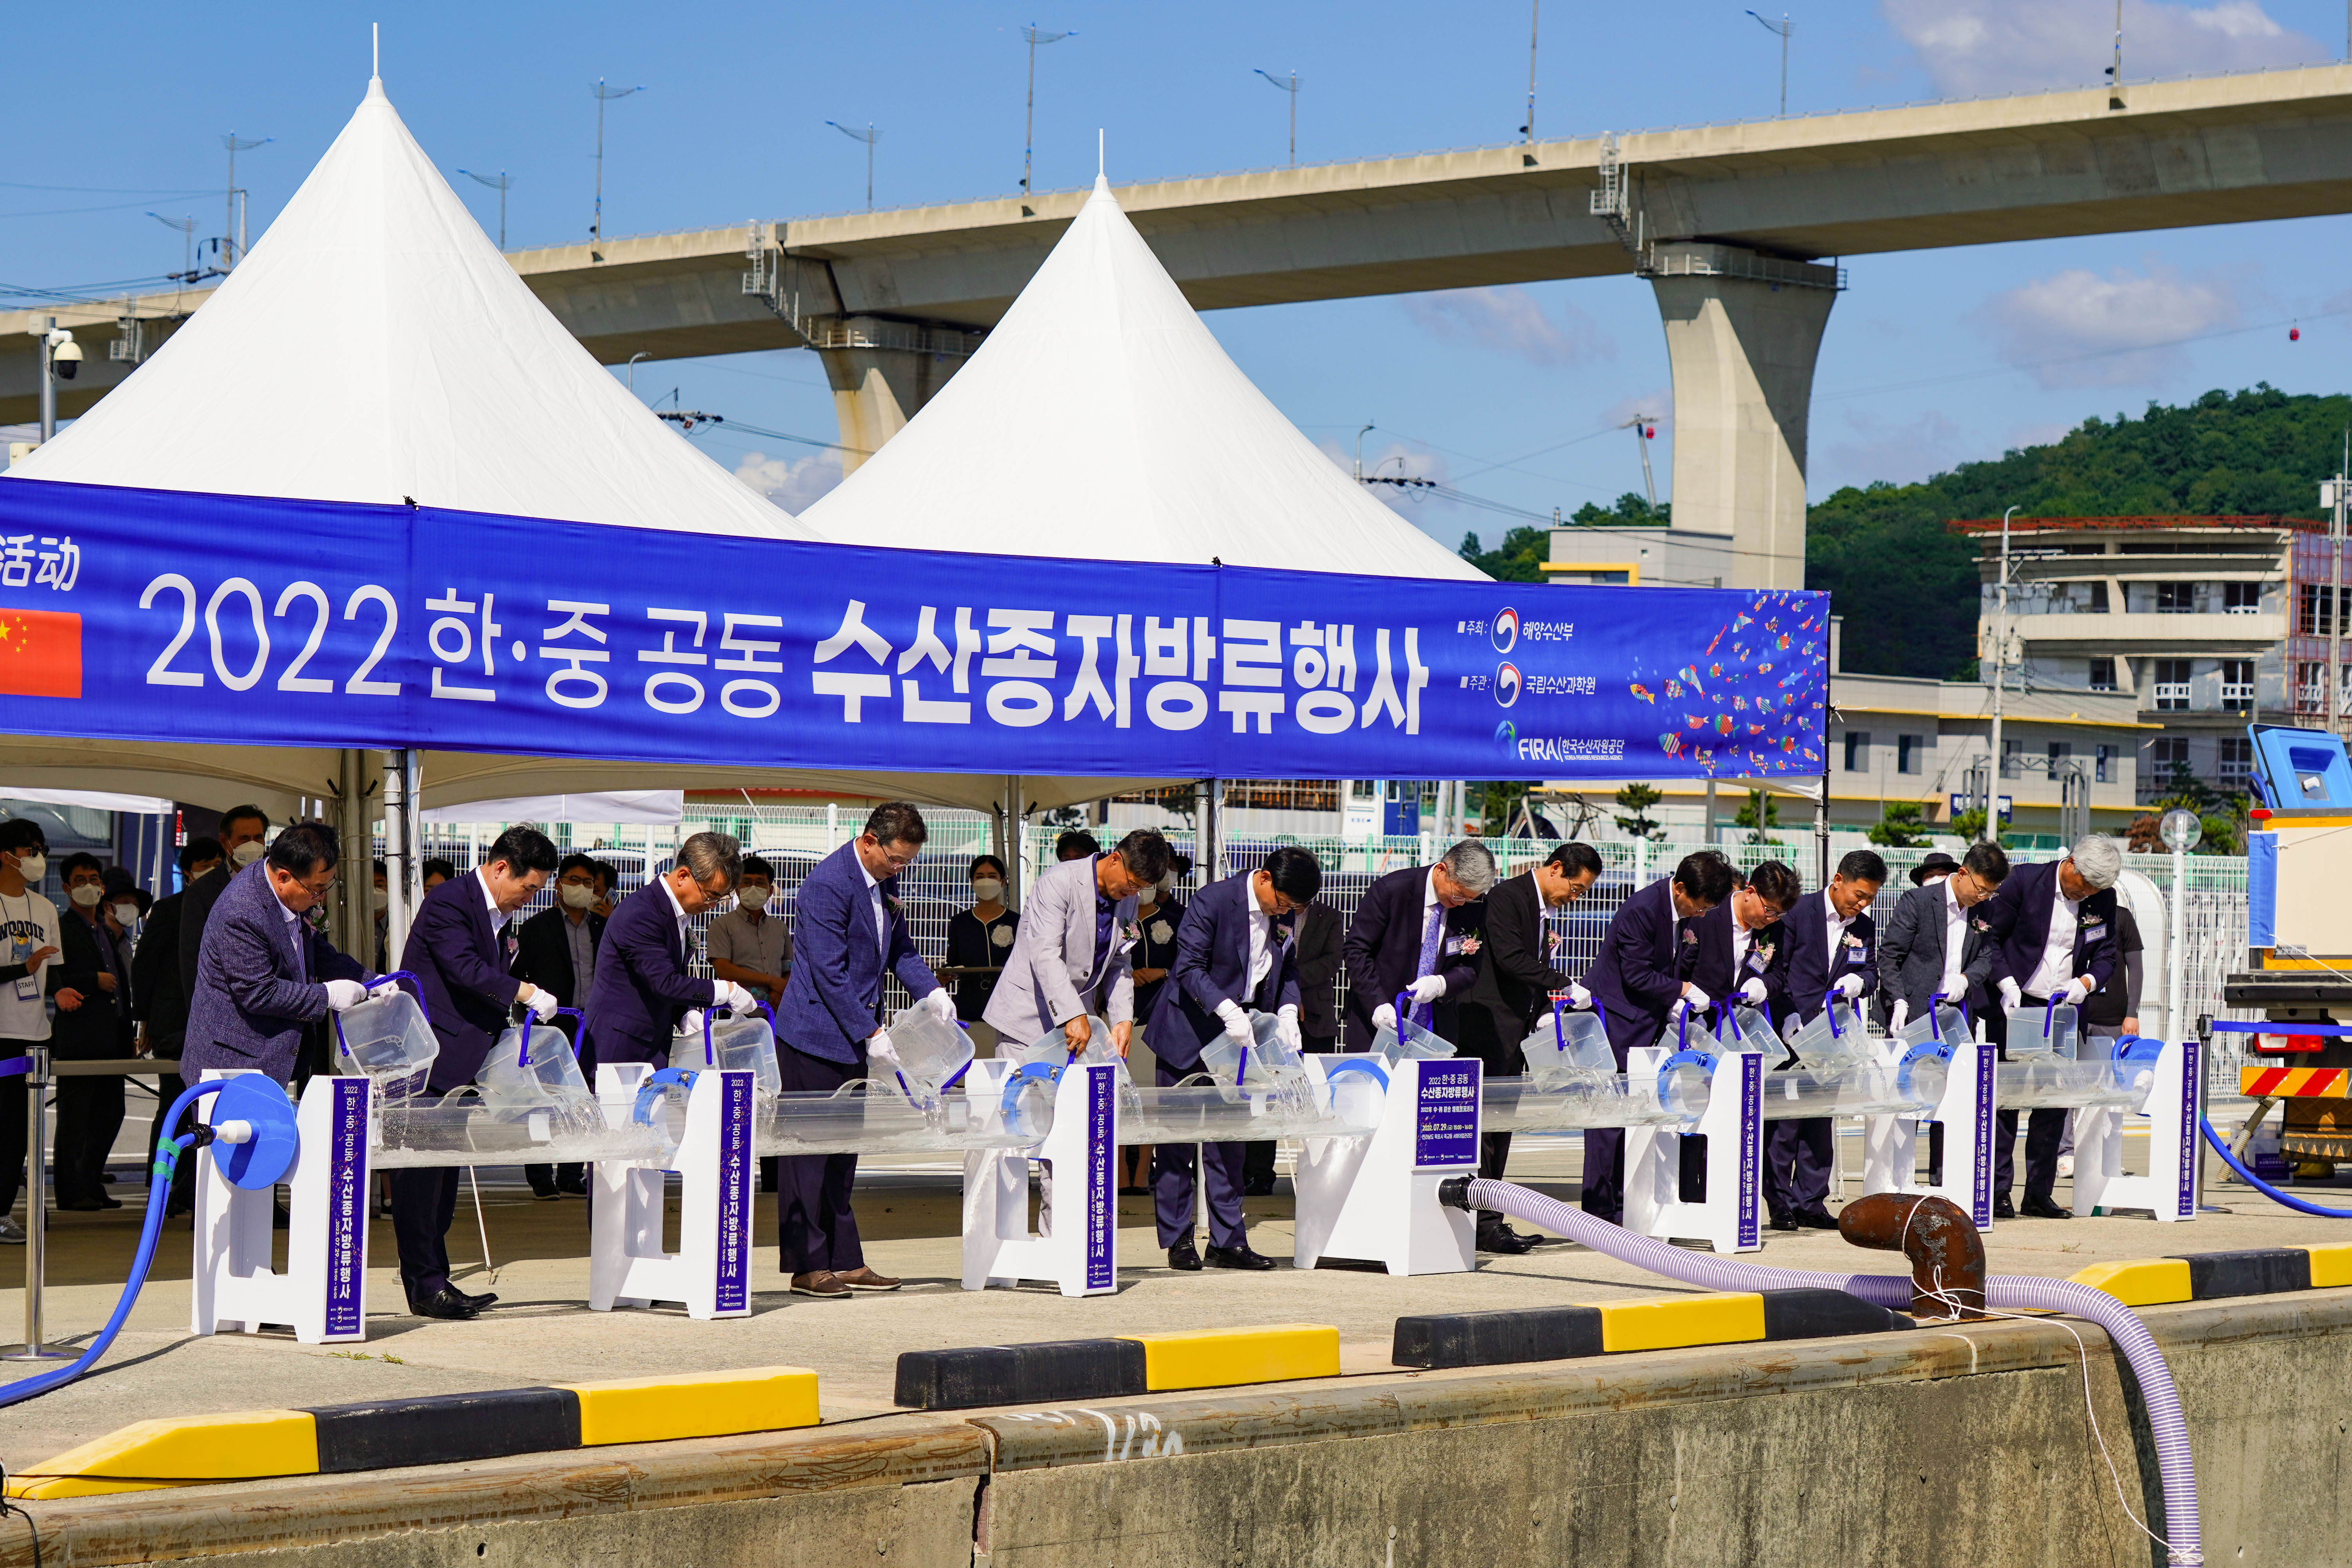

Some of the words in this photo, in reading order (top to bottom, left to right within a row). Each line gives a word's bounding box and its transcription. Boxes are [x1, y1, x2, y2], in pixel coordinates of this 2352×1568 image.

[1523, 622, 1573, 641] 해양수산부
[139, 573, 401, 695] 2022
[426, 588, 610, 708] 한·중
[638, 608, 783, 718] 공동
[812, 599, 1429, 735] 수산종자방류행사
[1526, 676, 1595, 694] 국립수산과학원
[1518, 739, 1558, 760] FIRA
[1562, 739, 1624, 754] 한국수산자원공단
[1442, 1074, 1455, 1084] 한·중
[1457, 1074, 1468, 1084] 공동
[733, 1089, 742, 1118] 한·중
[1421, 1086, 1474, 1099] 수산종자방류행사
[1983, 1084, 1987, 1104] 공동
[346, 1097, 356, 1129] 한·중
[1748, 1095, 1753, 1116] 공동
[732, 1124, 740, 1149] 공동
[1098, 1114, 1104, 1138] 공동
[345, 1134, 354, 1161] 공동
[1745, 1120, 1754, 1220] 수산종자방류행사
[1096, 1143, 1105, 1257] 수산종자방류행사
[727, 1154, 740, 1277] 수산종자방류행사
[339, 1167, 354, 1299] 수산종자방류행사
